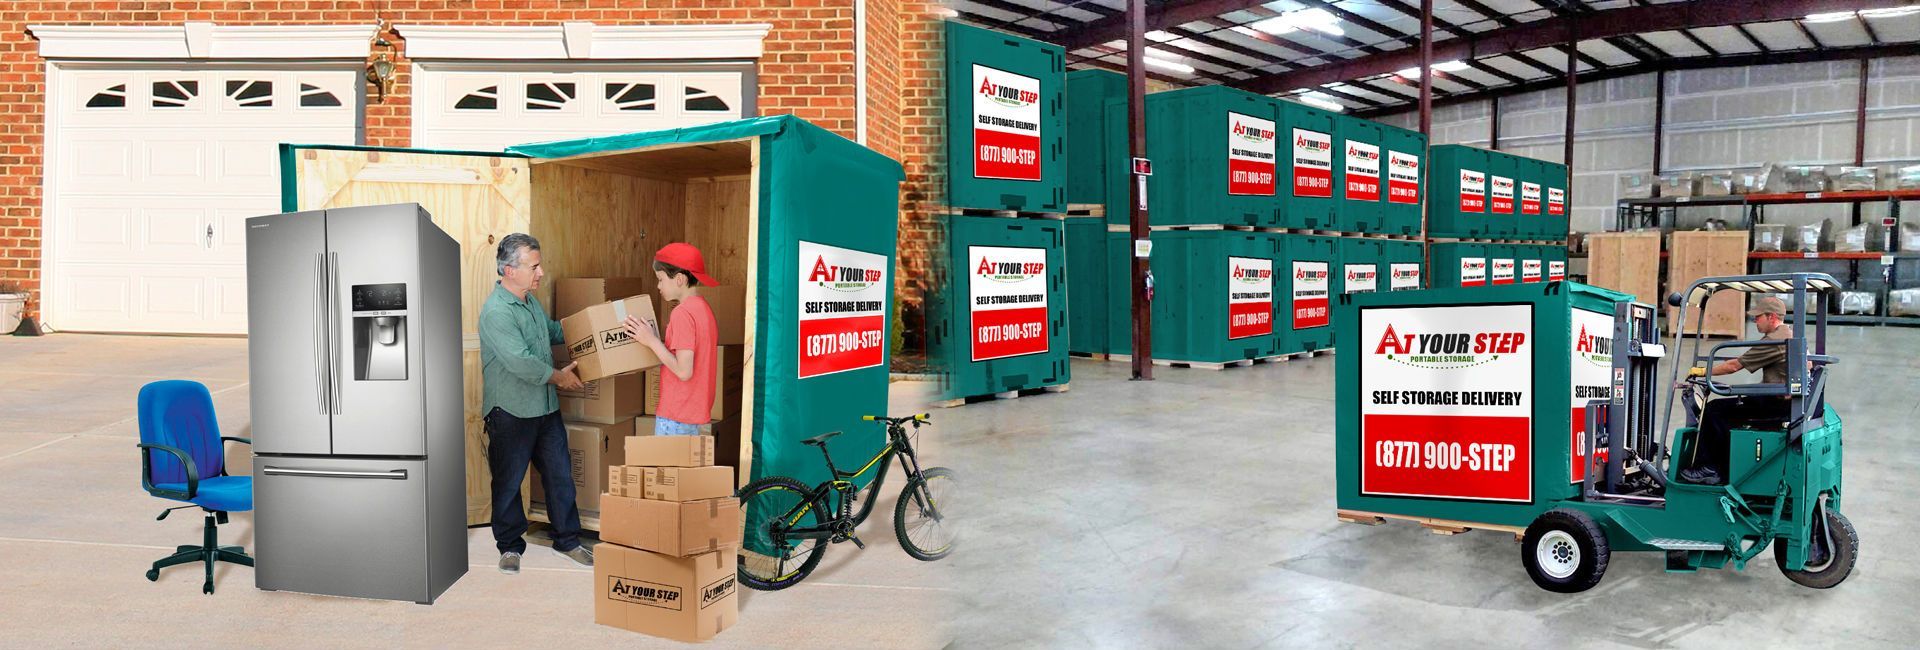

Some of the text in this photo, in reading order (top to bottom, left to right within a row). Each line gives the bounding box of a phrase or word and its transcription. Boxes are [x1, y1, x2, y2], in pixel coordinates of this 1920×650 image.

[979, 75, 1038, 104] AT YOUR STEP
[979, 114, 1037, 131] SELF STORAGE DELIVERY
[1233, 120, 1246, 134] AT
[1246, 126, 1260, 137] YOUR
[1261, 130, 1274, 139] STEP
[1297, 134, 1306, 146] AT
[980, 144, 1036, 165] (877) 900-STEP
[808, 254, 881, 282] AT YOUR STEP
[977, 256, 1044, 274] AT YOUR STEP
[1233, 264, 1245, 278] AT
[1296, 267, 1305, 278] AT
[806, 301, 882, 313] SELF STORAGE DELIVERY
[976, 294, 1044, 305] SELF STORAGE DELIVERY
[605, 332, 618, 344] AT
[979, 322, 1042, 343] (877) 900-STEP
[1374, 323, 1525, 354] AT YOUR STEP
[1576, 323, 1594, 352] AT
[807, 330, 881, 357] (877) 900-STEP
[1373, 391, 1522, 406] SELF STORAGE DELIVERY
[1576, 385, 1610, 400] SELF STORAGE
[1376, 440, 1515, 472] (877) 900-STEP
[612, 579, 679, 601] AT YOUR STEP
[703, 588, 712, 601] AT
